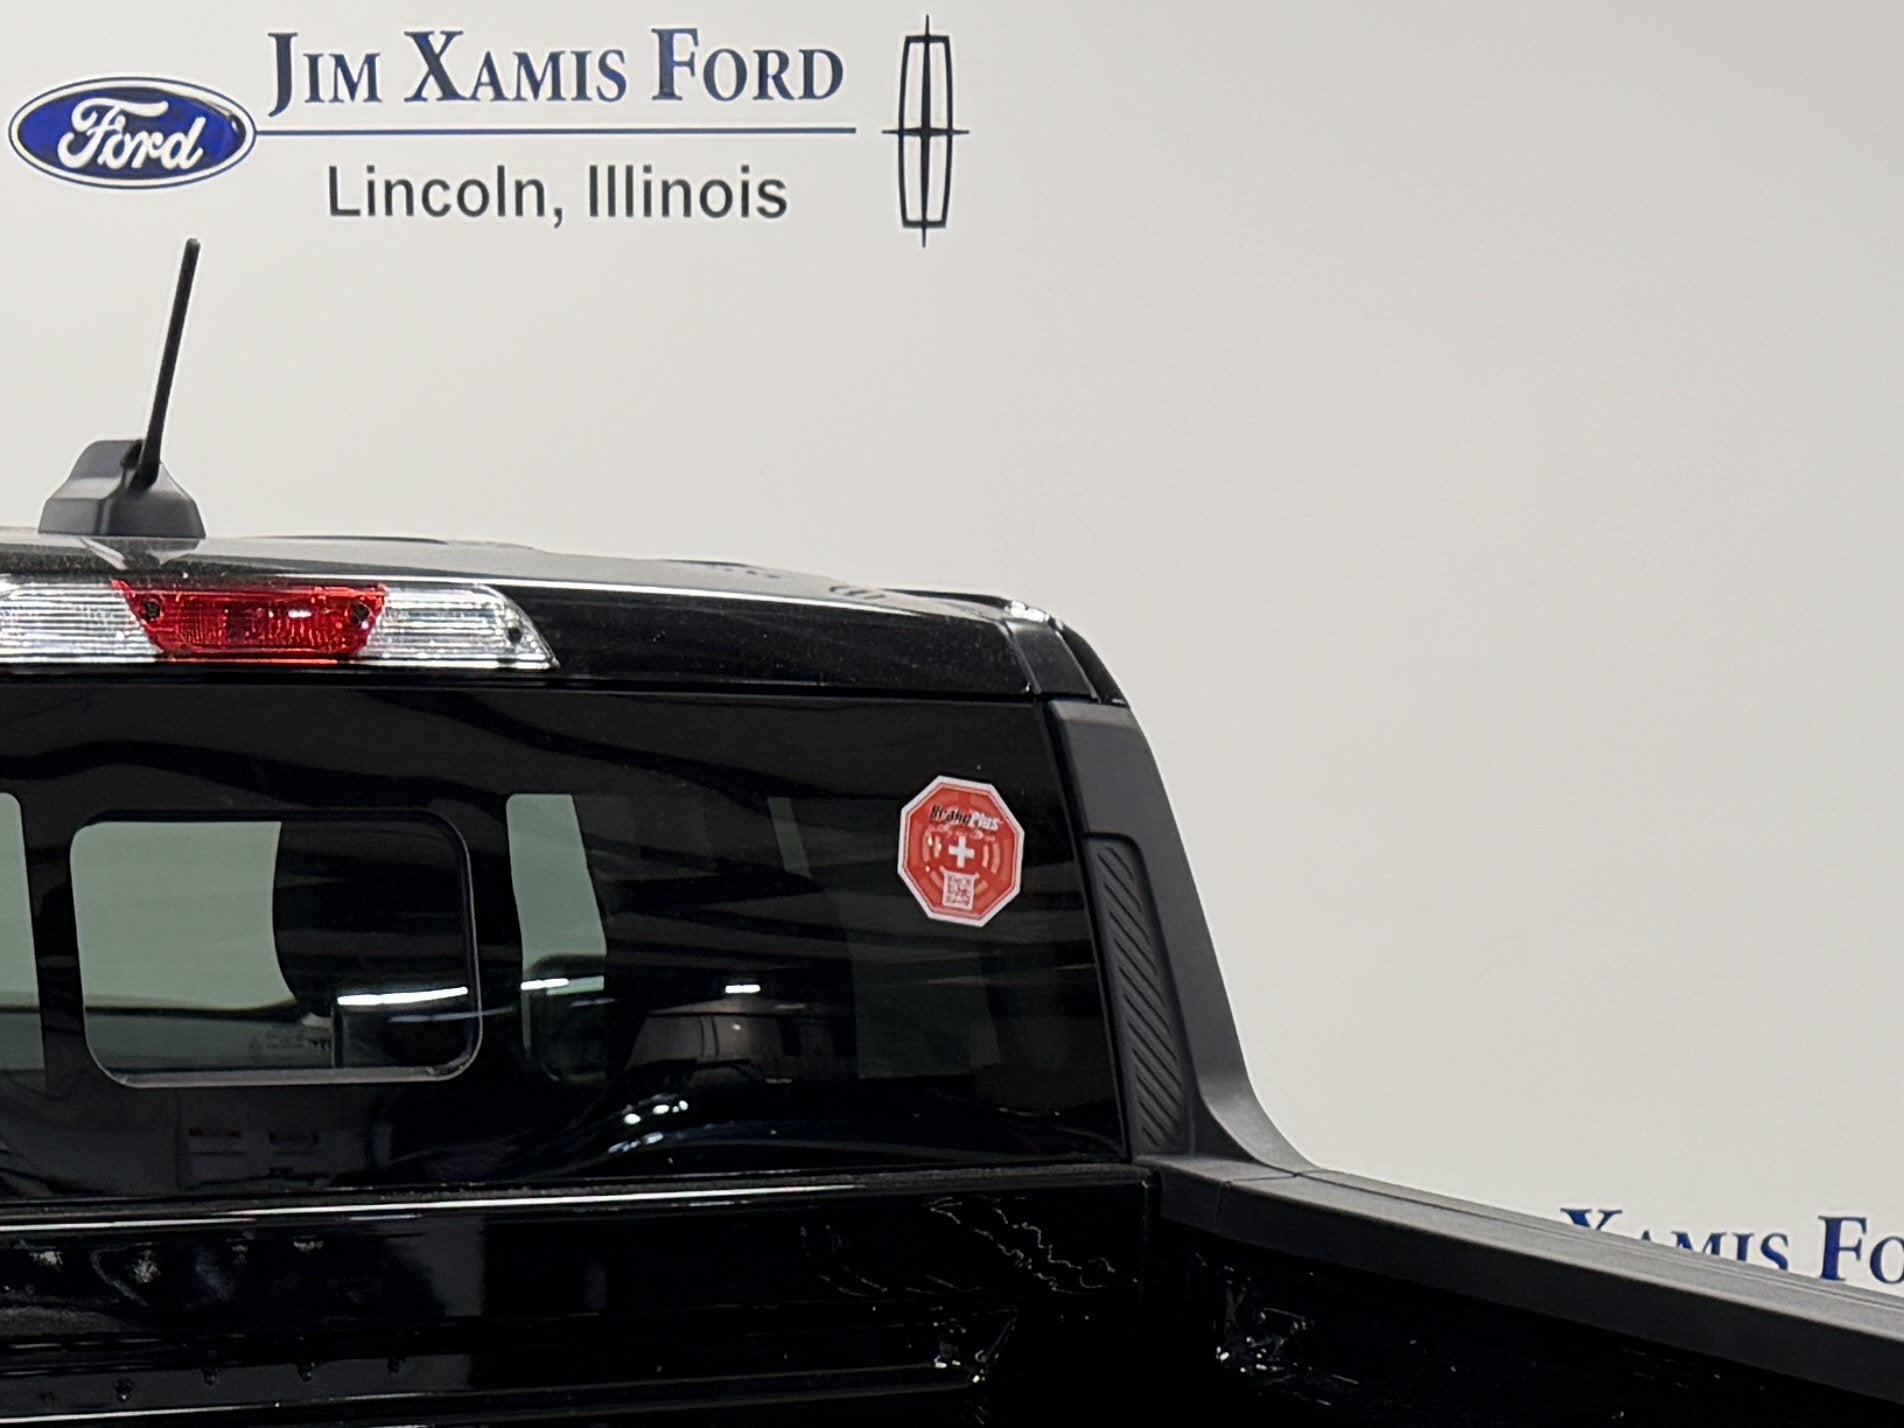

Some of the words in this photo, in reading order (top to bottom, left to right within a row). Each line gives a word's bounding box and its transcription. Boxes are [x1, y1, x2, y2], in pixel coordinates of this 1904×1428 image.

[267, 31, 383, 118] JIM
[403, 30, 628, 103] XAMIS
[650, 27, 844, 102] FORD
[57, 97, 207, 170] Ford
[328, 164, 563, 229] Lincoln,
[589, 164, 788, 220] Illinois
